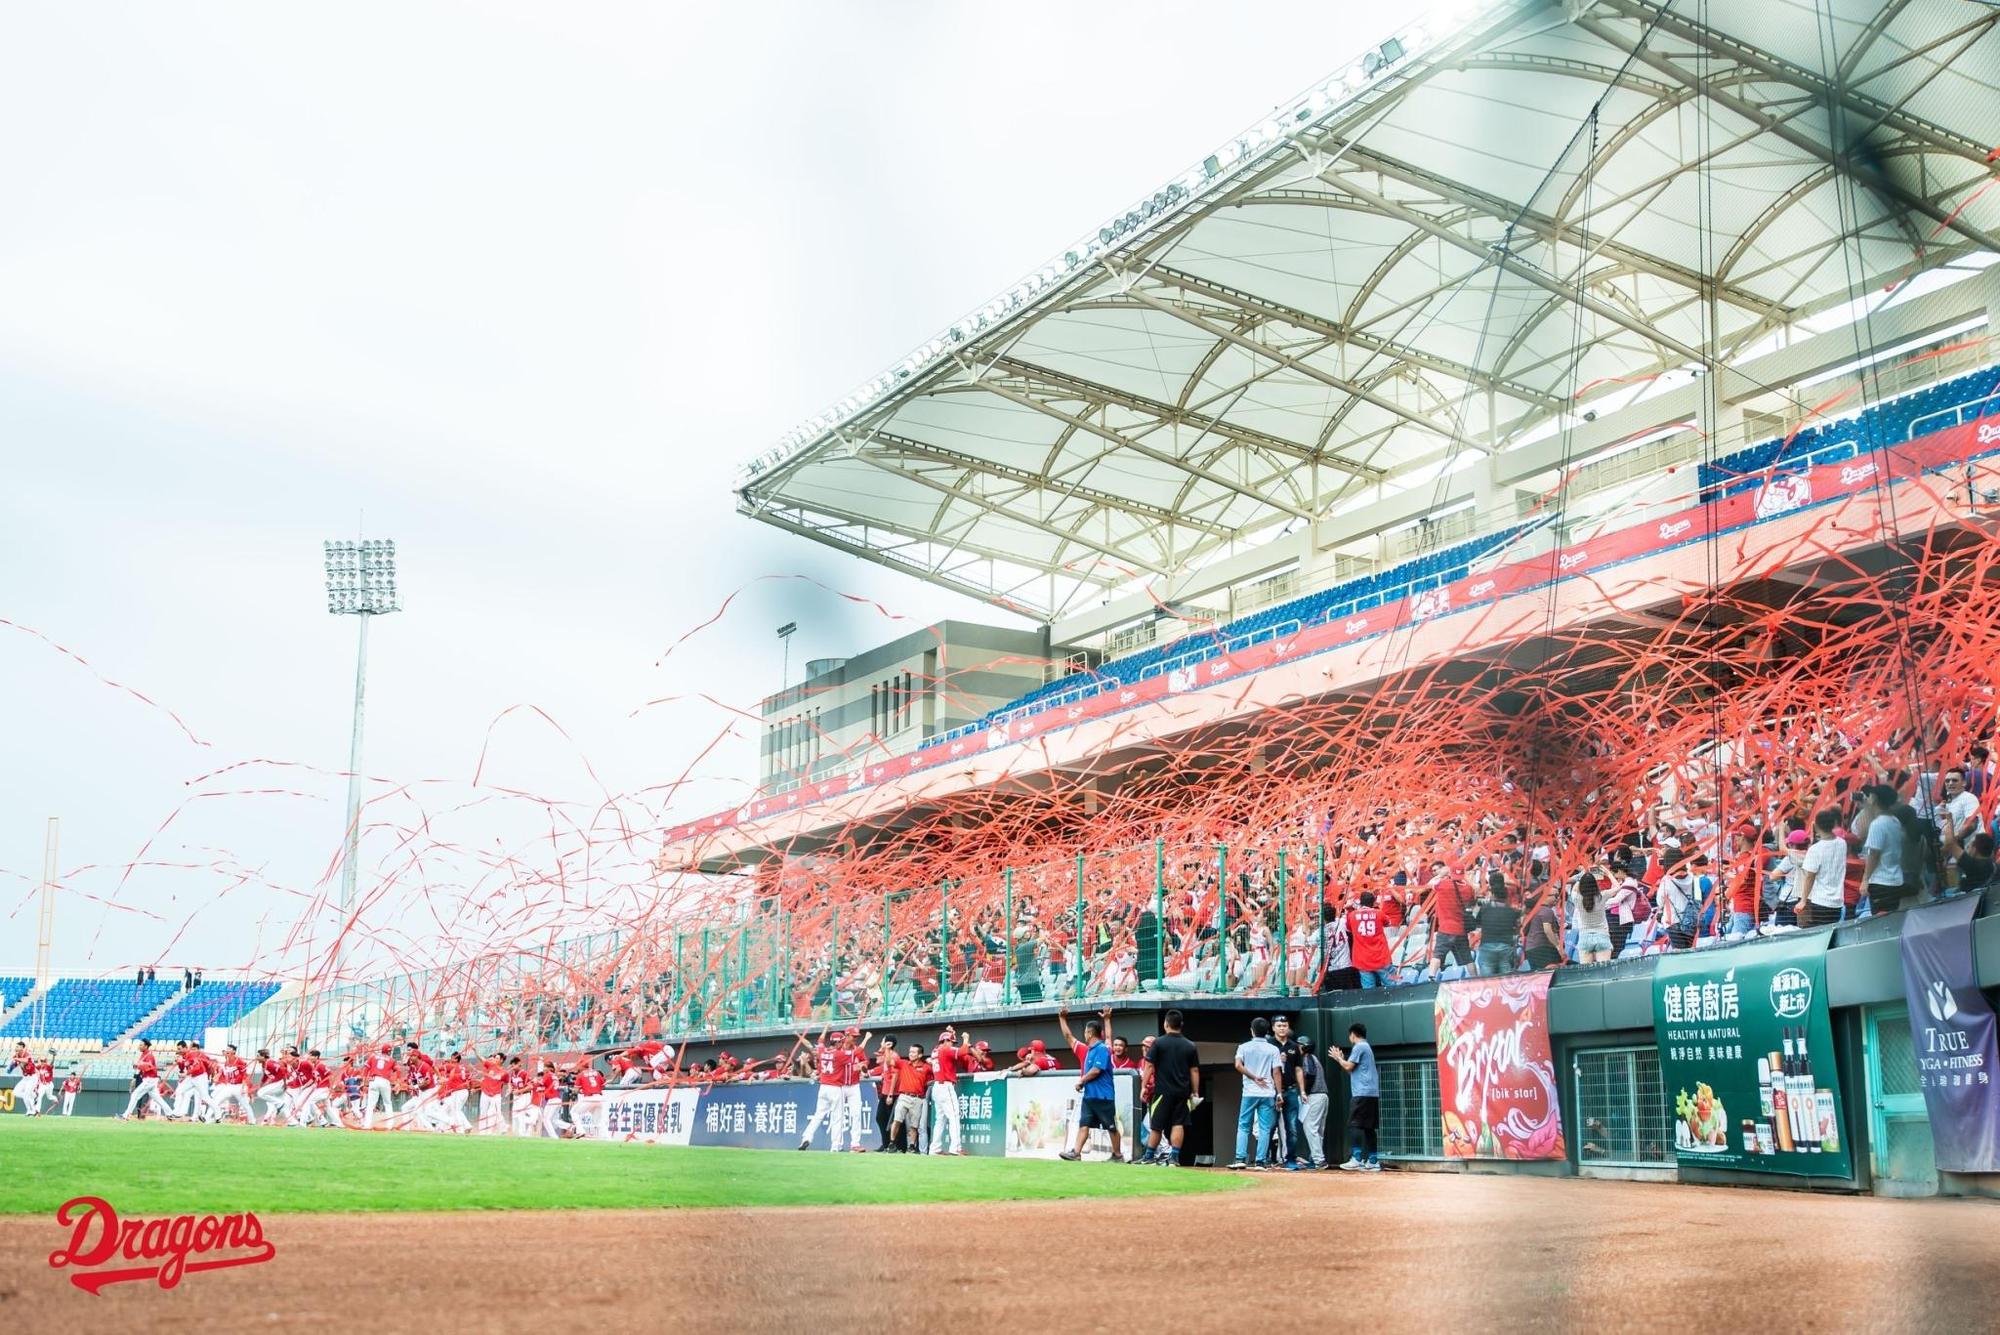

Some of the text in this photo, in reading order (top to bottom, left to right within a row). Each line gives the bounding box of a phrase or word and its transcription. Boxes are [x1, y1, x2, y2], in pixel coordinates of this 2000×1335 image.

[1358, 921, 1376, 936] 49
[1663, 980, 1740, 1023] 健康廚房
[1668, 1027, 1741, 1041] HEALTHY & NATURAL
[821, 1060, 834, 1074] 54
[1950, 1054, 1983, 1069] FITNESS
[958, 1093, 993, 1119] 康廚房
